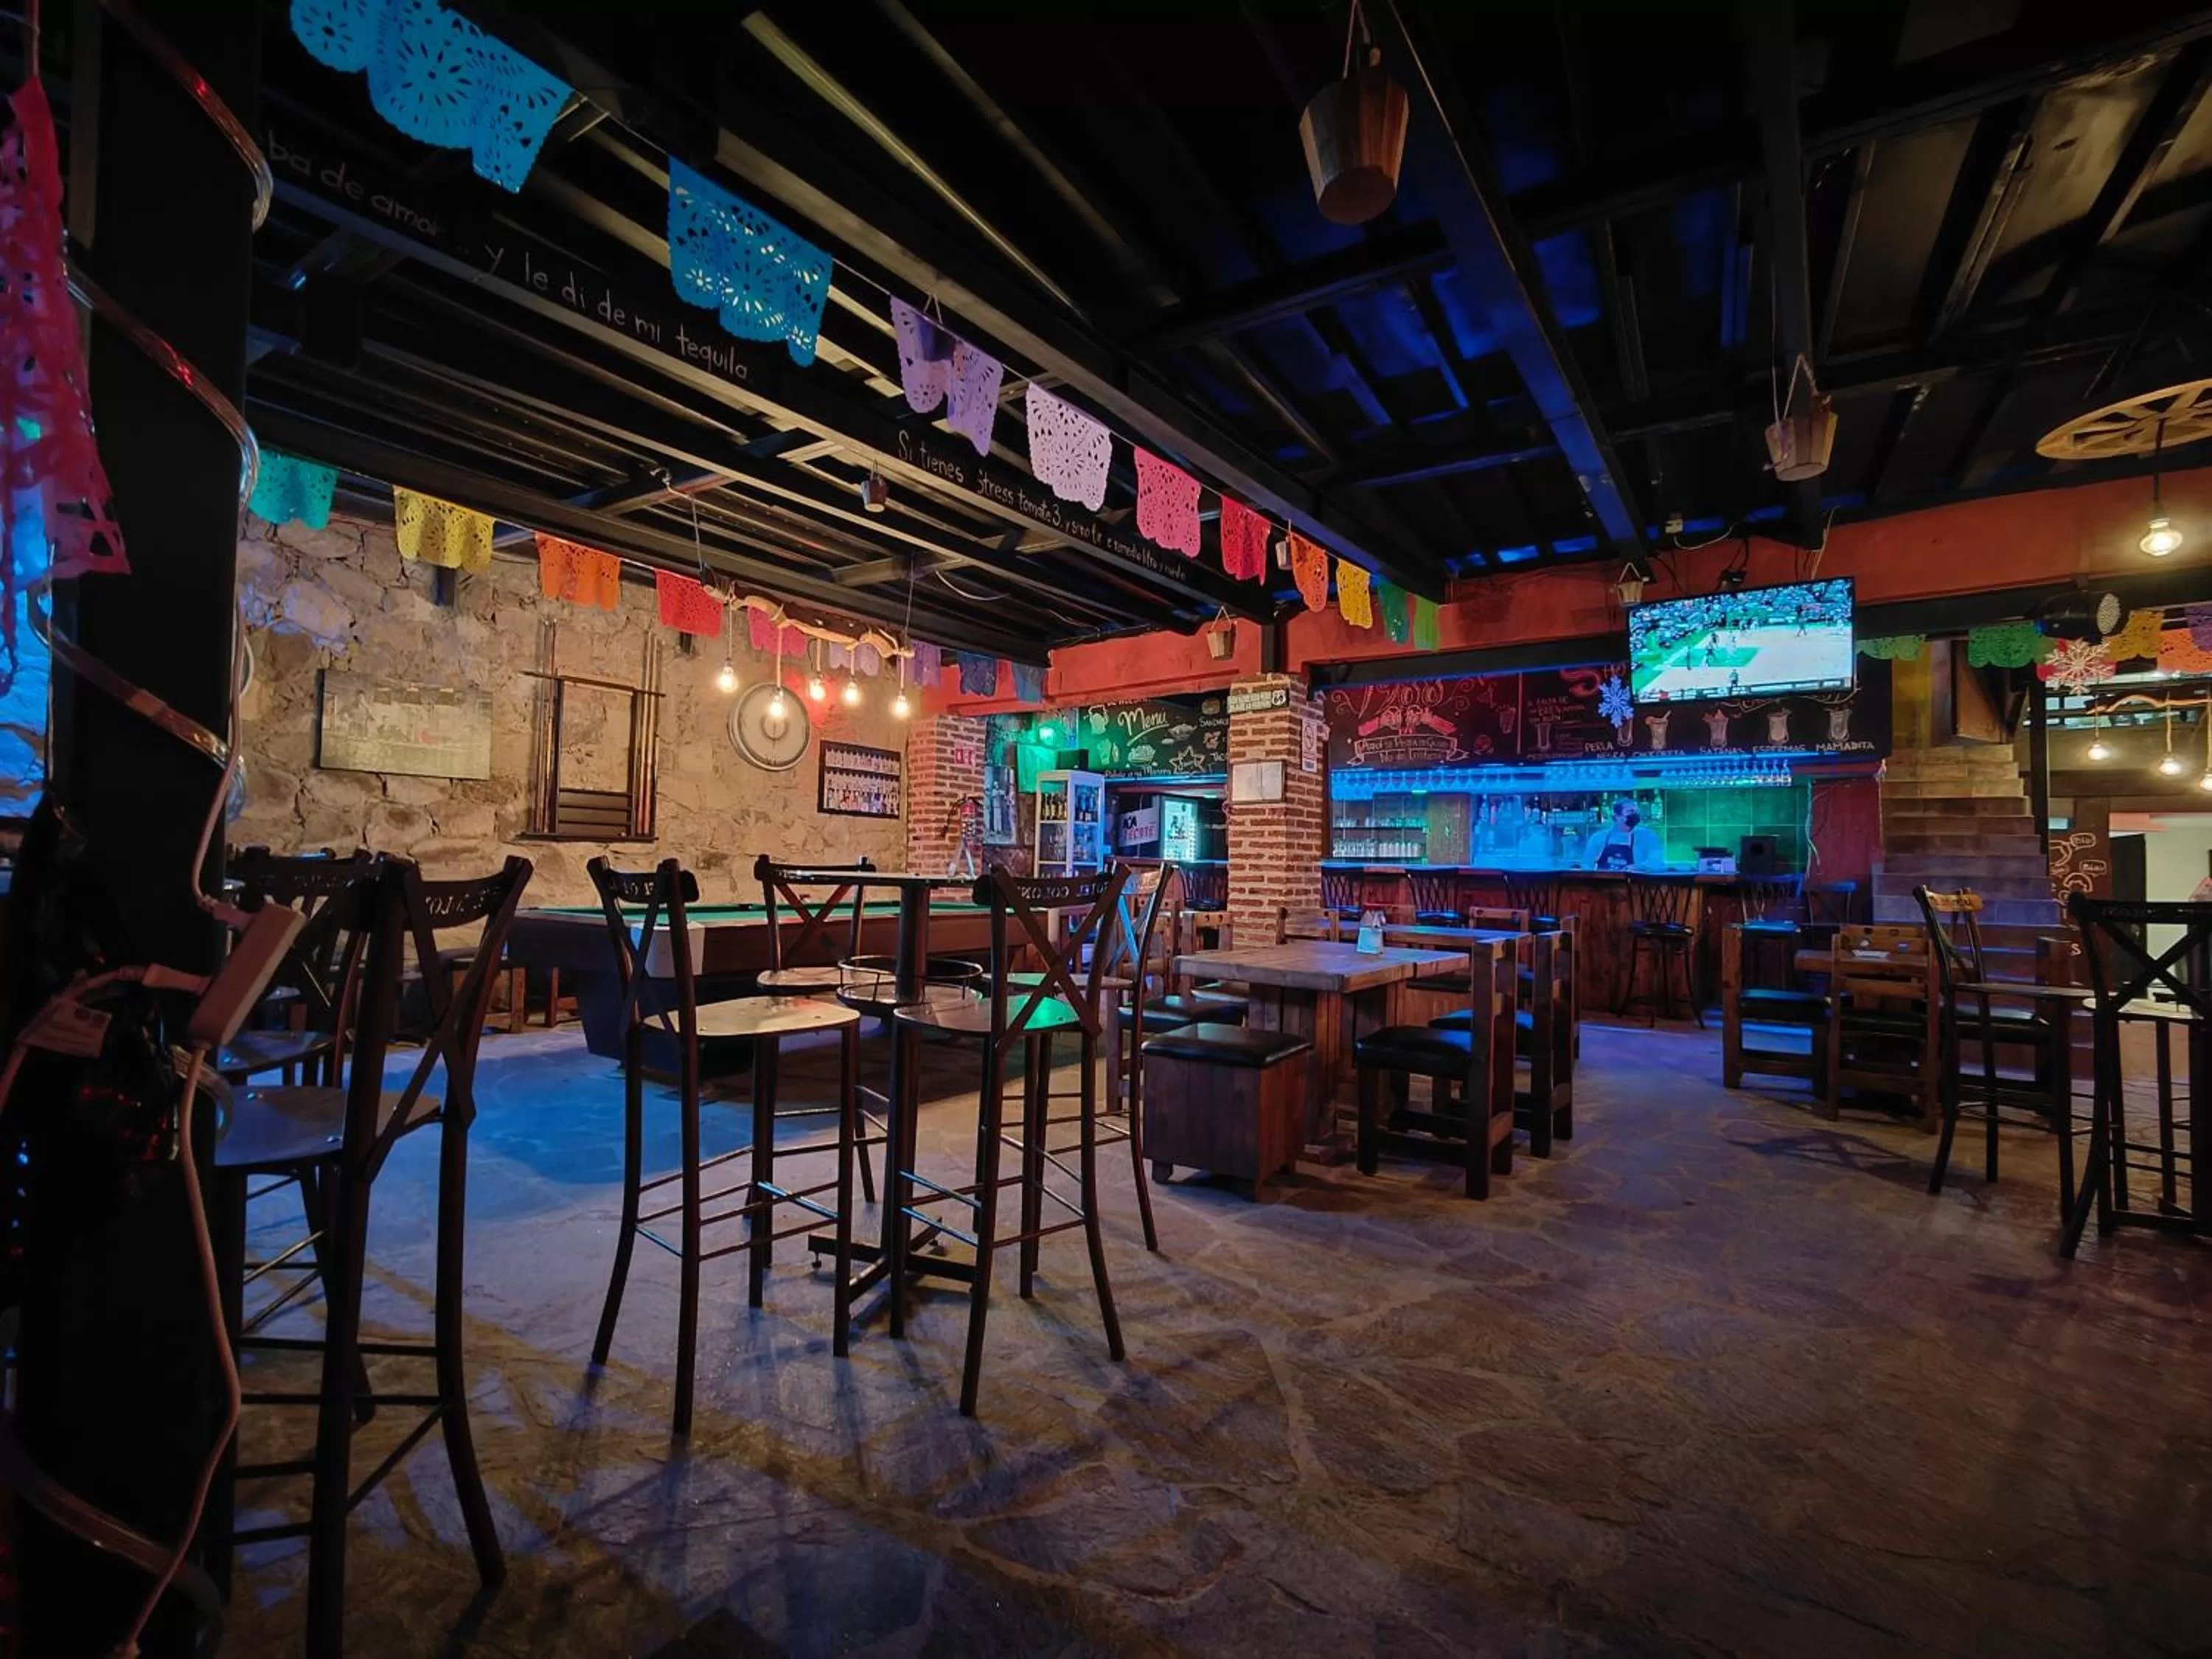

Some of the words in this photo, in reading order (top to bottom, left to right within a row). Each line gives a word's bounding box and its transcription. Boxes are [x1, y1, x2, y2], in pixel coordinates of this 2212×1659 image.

[319, 159, 365, 201] de
[370, 193, 439, 237] amor
[483, 243, 505, 274] y
[524, 251, 549, 291] le
[560, 271, 587, 310] di
[597, 288, 626, 326] de
[633, 314, 661, 344] mi
[675, 321, 748, 380] tequila
[919, 439, 965, 484] tienes
